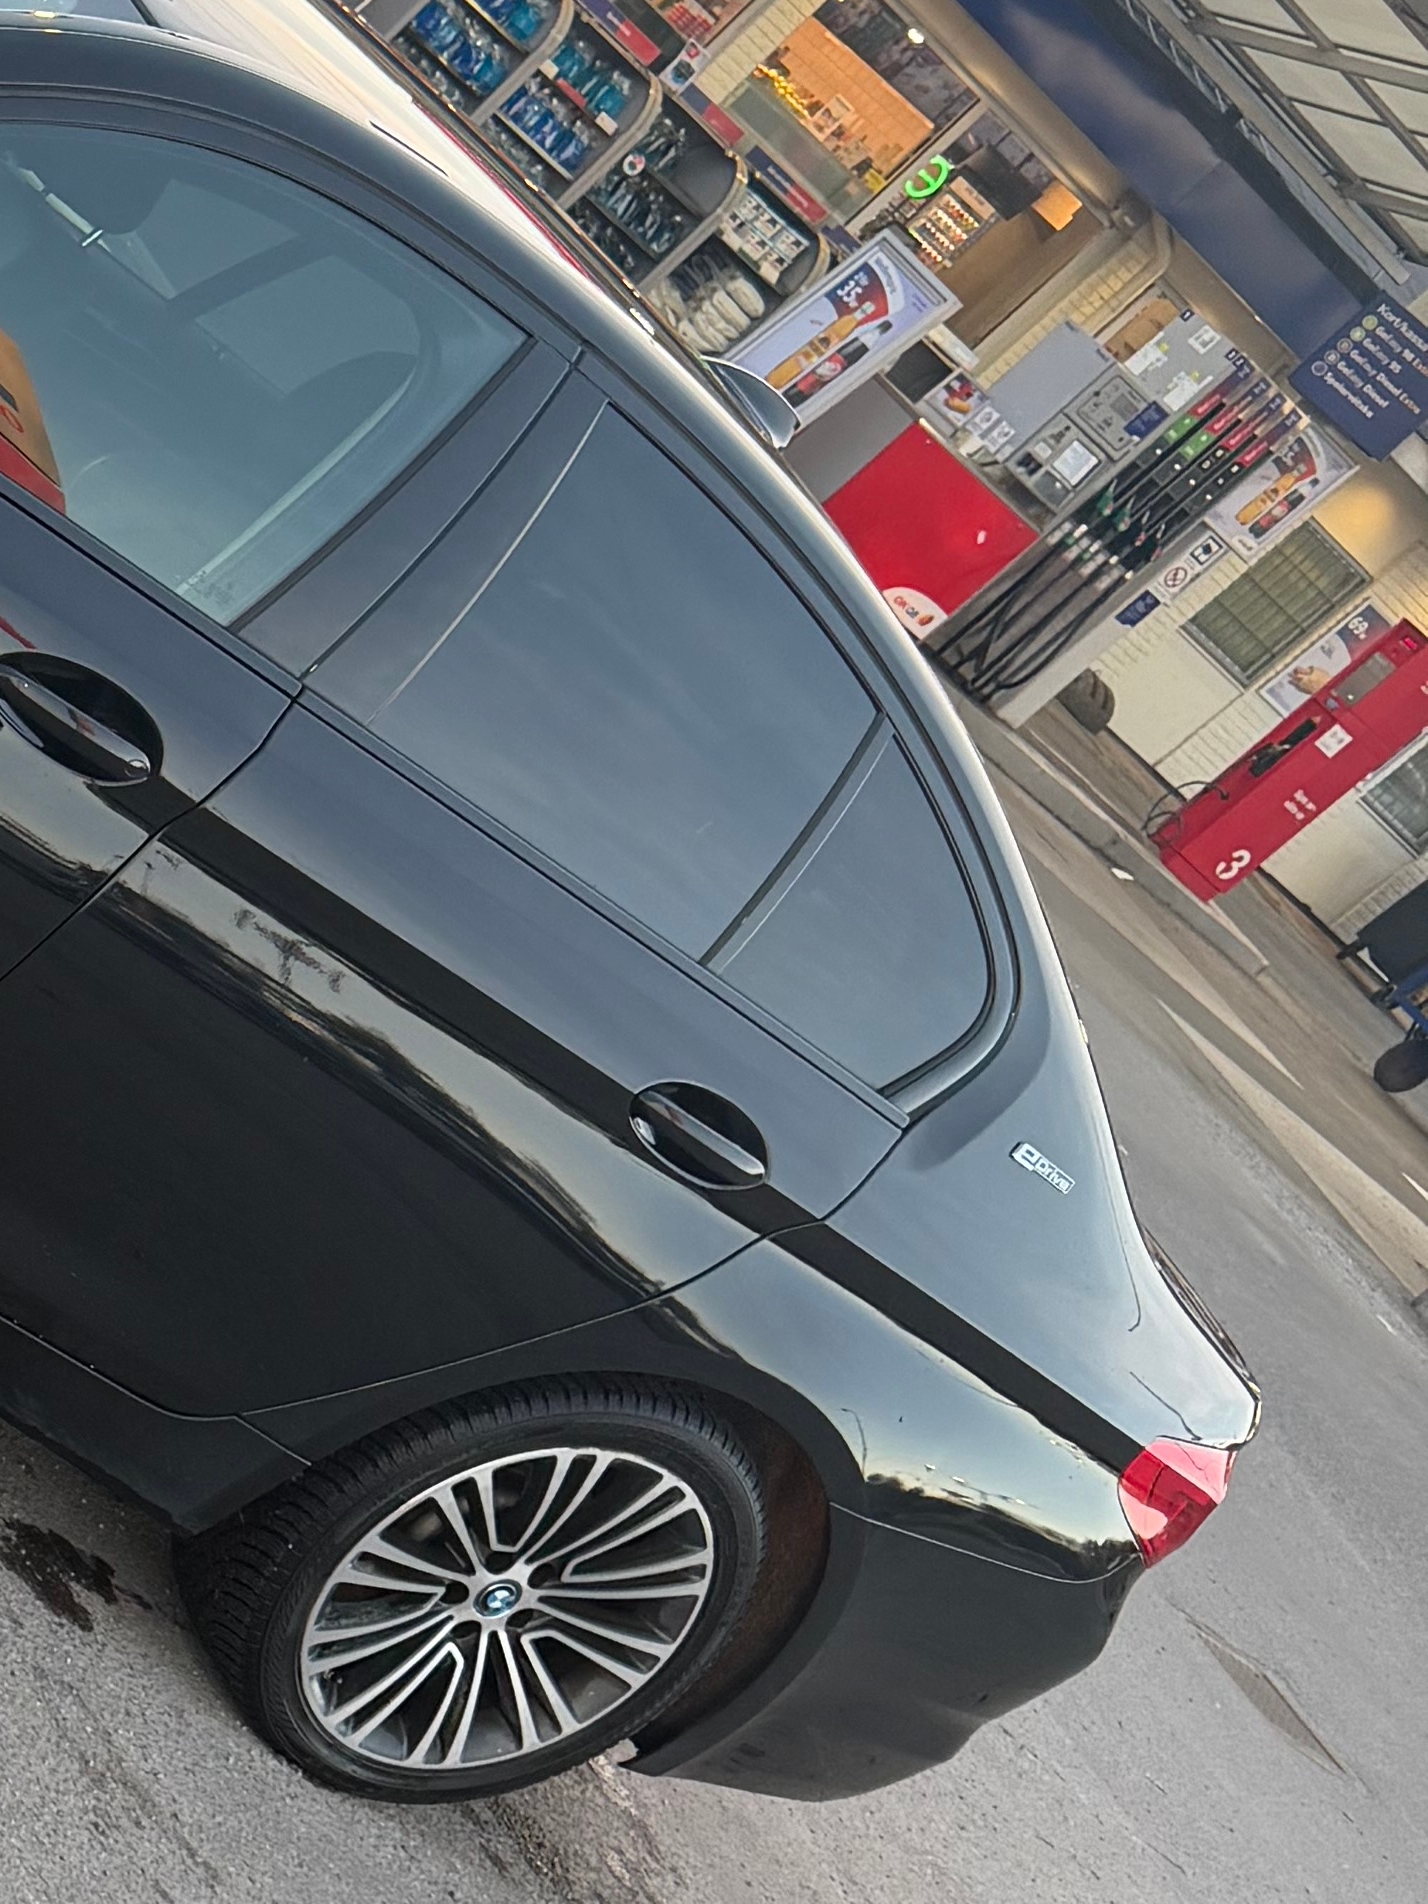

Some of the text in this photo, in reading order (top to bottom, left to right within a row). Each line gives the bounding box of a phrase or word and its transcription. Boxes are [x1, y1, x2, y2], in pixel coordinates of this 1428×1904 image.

[837, 280, 862, 303] 35
[1347, 615, 1369, 637] 69
[1215, 849, 1251, 880] 3
